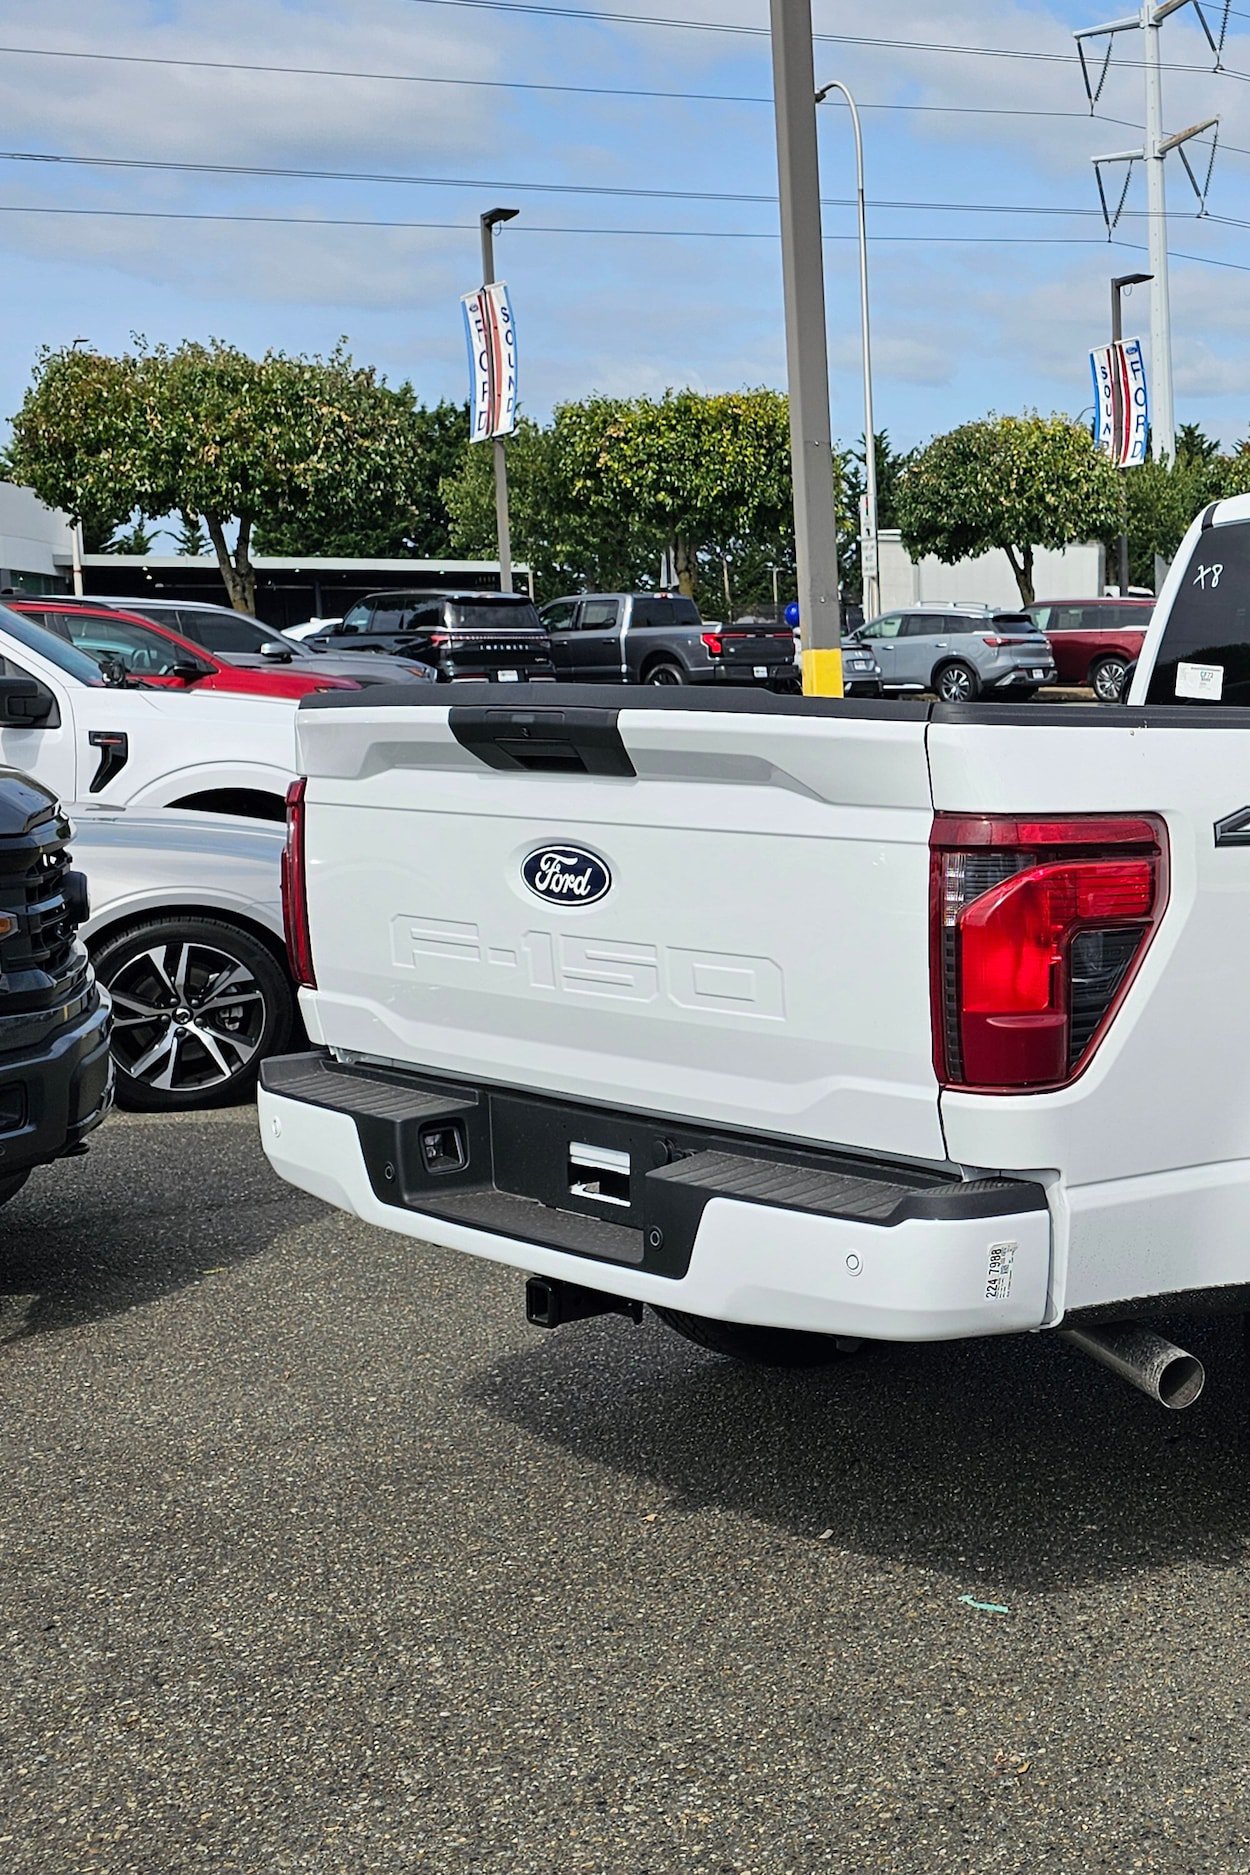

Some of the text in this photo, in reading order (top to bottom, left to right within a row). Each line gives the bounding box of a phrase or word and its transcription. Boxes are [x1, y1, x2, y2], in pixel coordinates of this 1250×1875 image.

[1130, 361, 1146, 459] FORD
[534, 852, 593, 896] Ford
[391, 914, 787, 1022] F-150
[985, 1248, 1002, 1298] 224 7988
